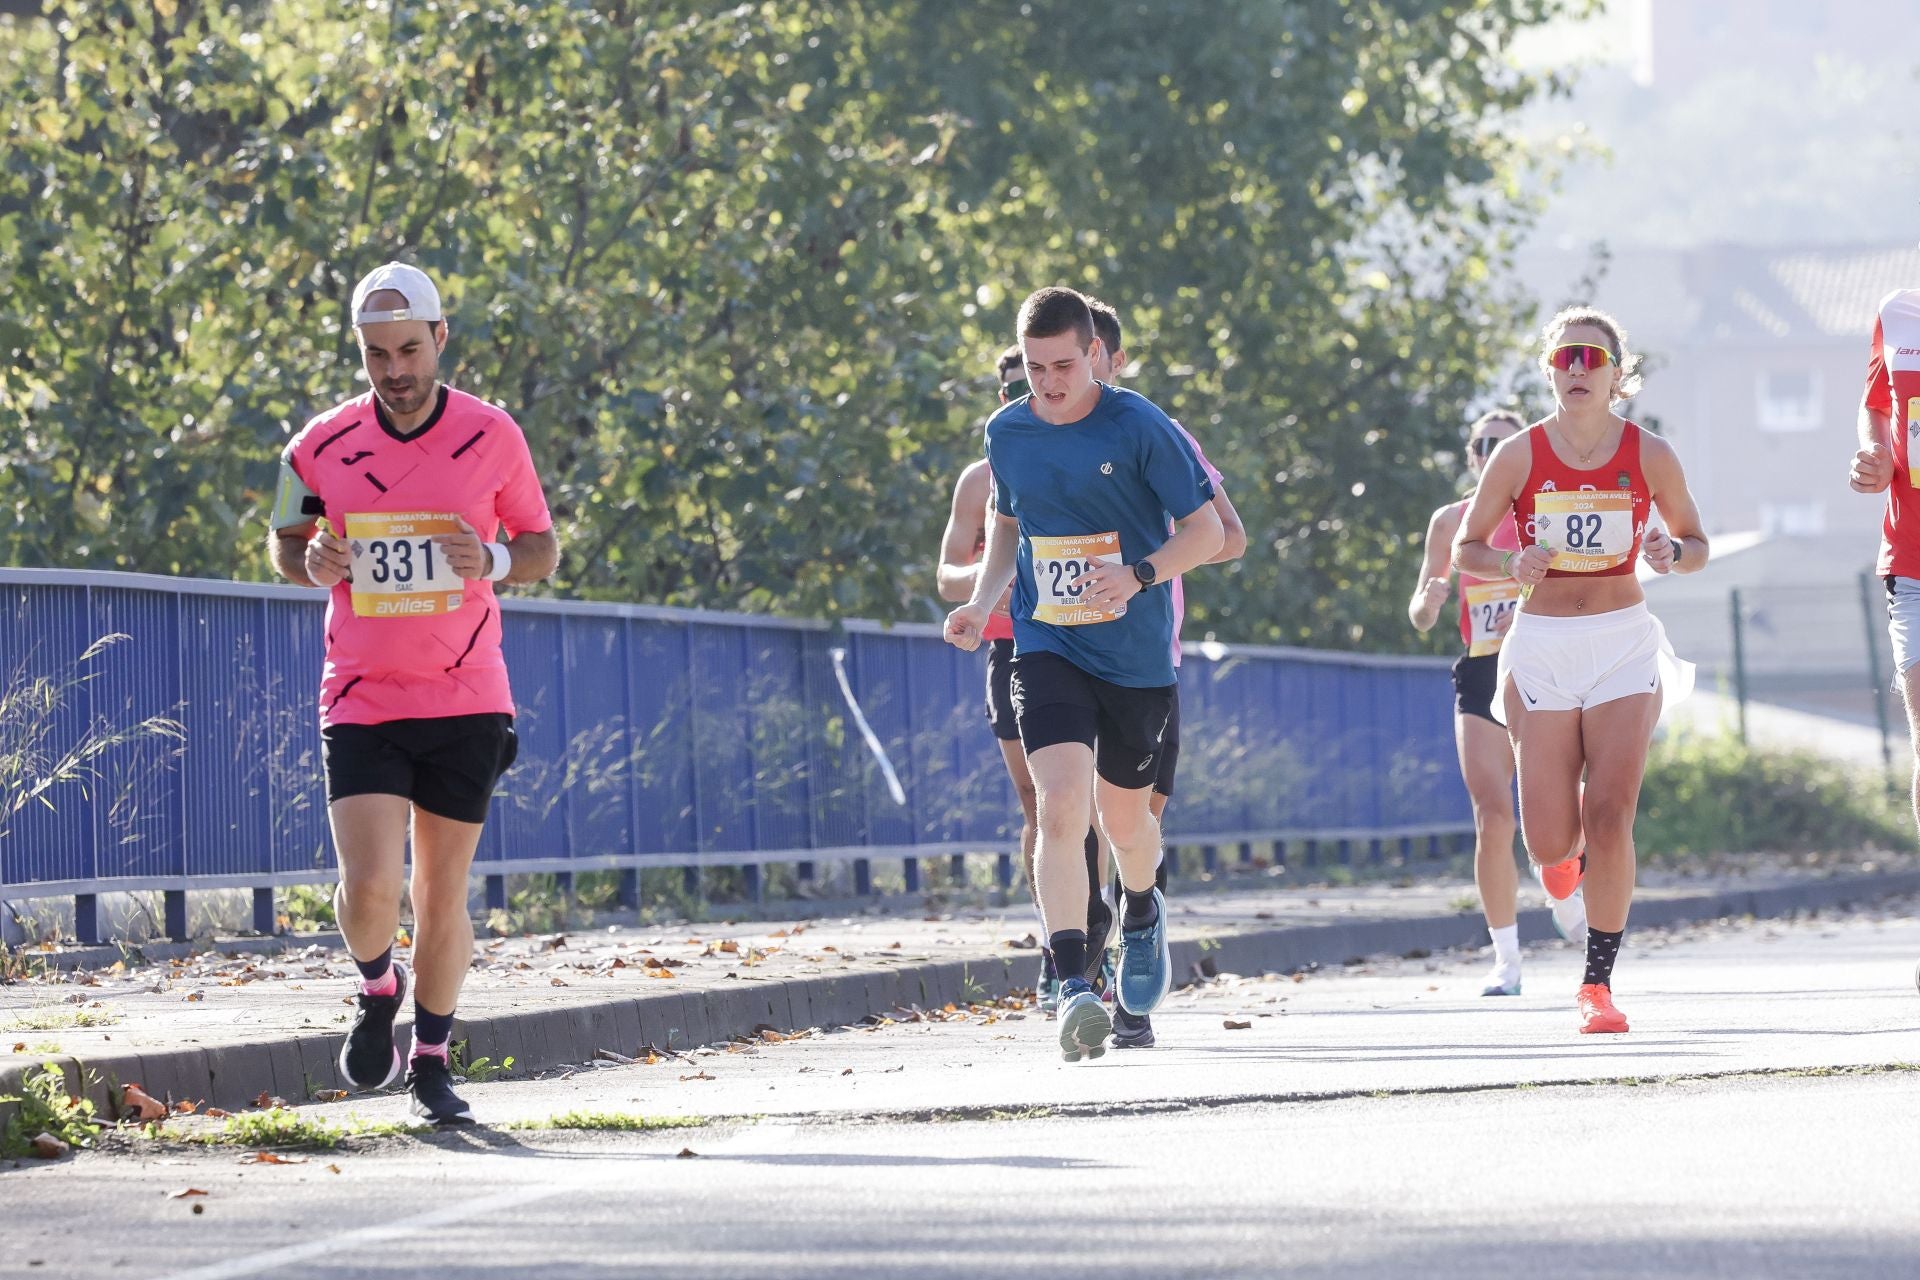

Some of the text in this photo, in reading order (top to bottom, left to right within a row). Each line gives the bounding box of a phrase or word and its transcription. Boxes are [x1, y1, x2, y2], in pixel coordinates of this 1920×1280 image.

[1576, 492, 1609, 500] MARATÓN
[1609, 492, 1631, 500] AVILÉS
[1573, 502, 1594, 510] 2024
[432, 512, 456, 521] AVILÉ
[389, 525, 415, 534] 2024
[1566, 514, 1602, 548] 82
[1063, 536, 1096, 545] MARATÓN
[1061, 548, 1082, 556] 2024
[1565, 547, 1584, 555] MARINA
[370, 539, 434, 583] 331
[395, 584, 414, 592] ISAAC
[376, 597, 436, 614] avilés
[1056, 609, 1103, 623] avilés
